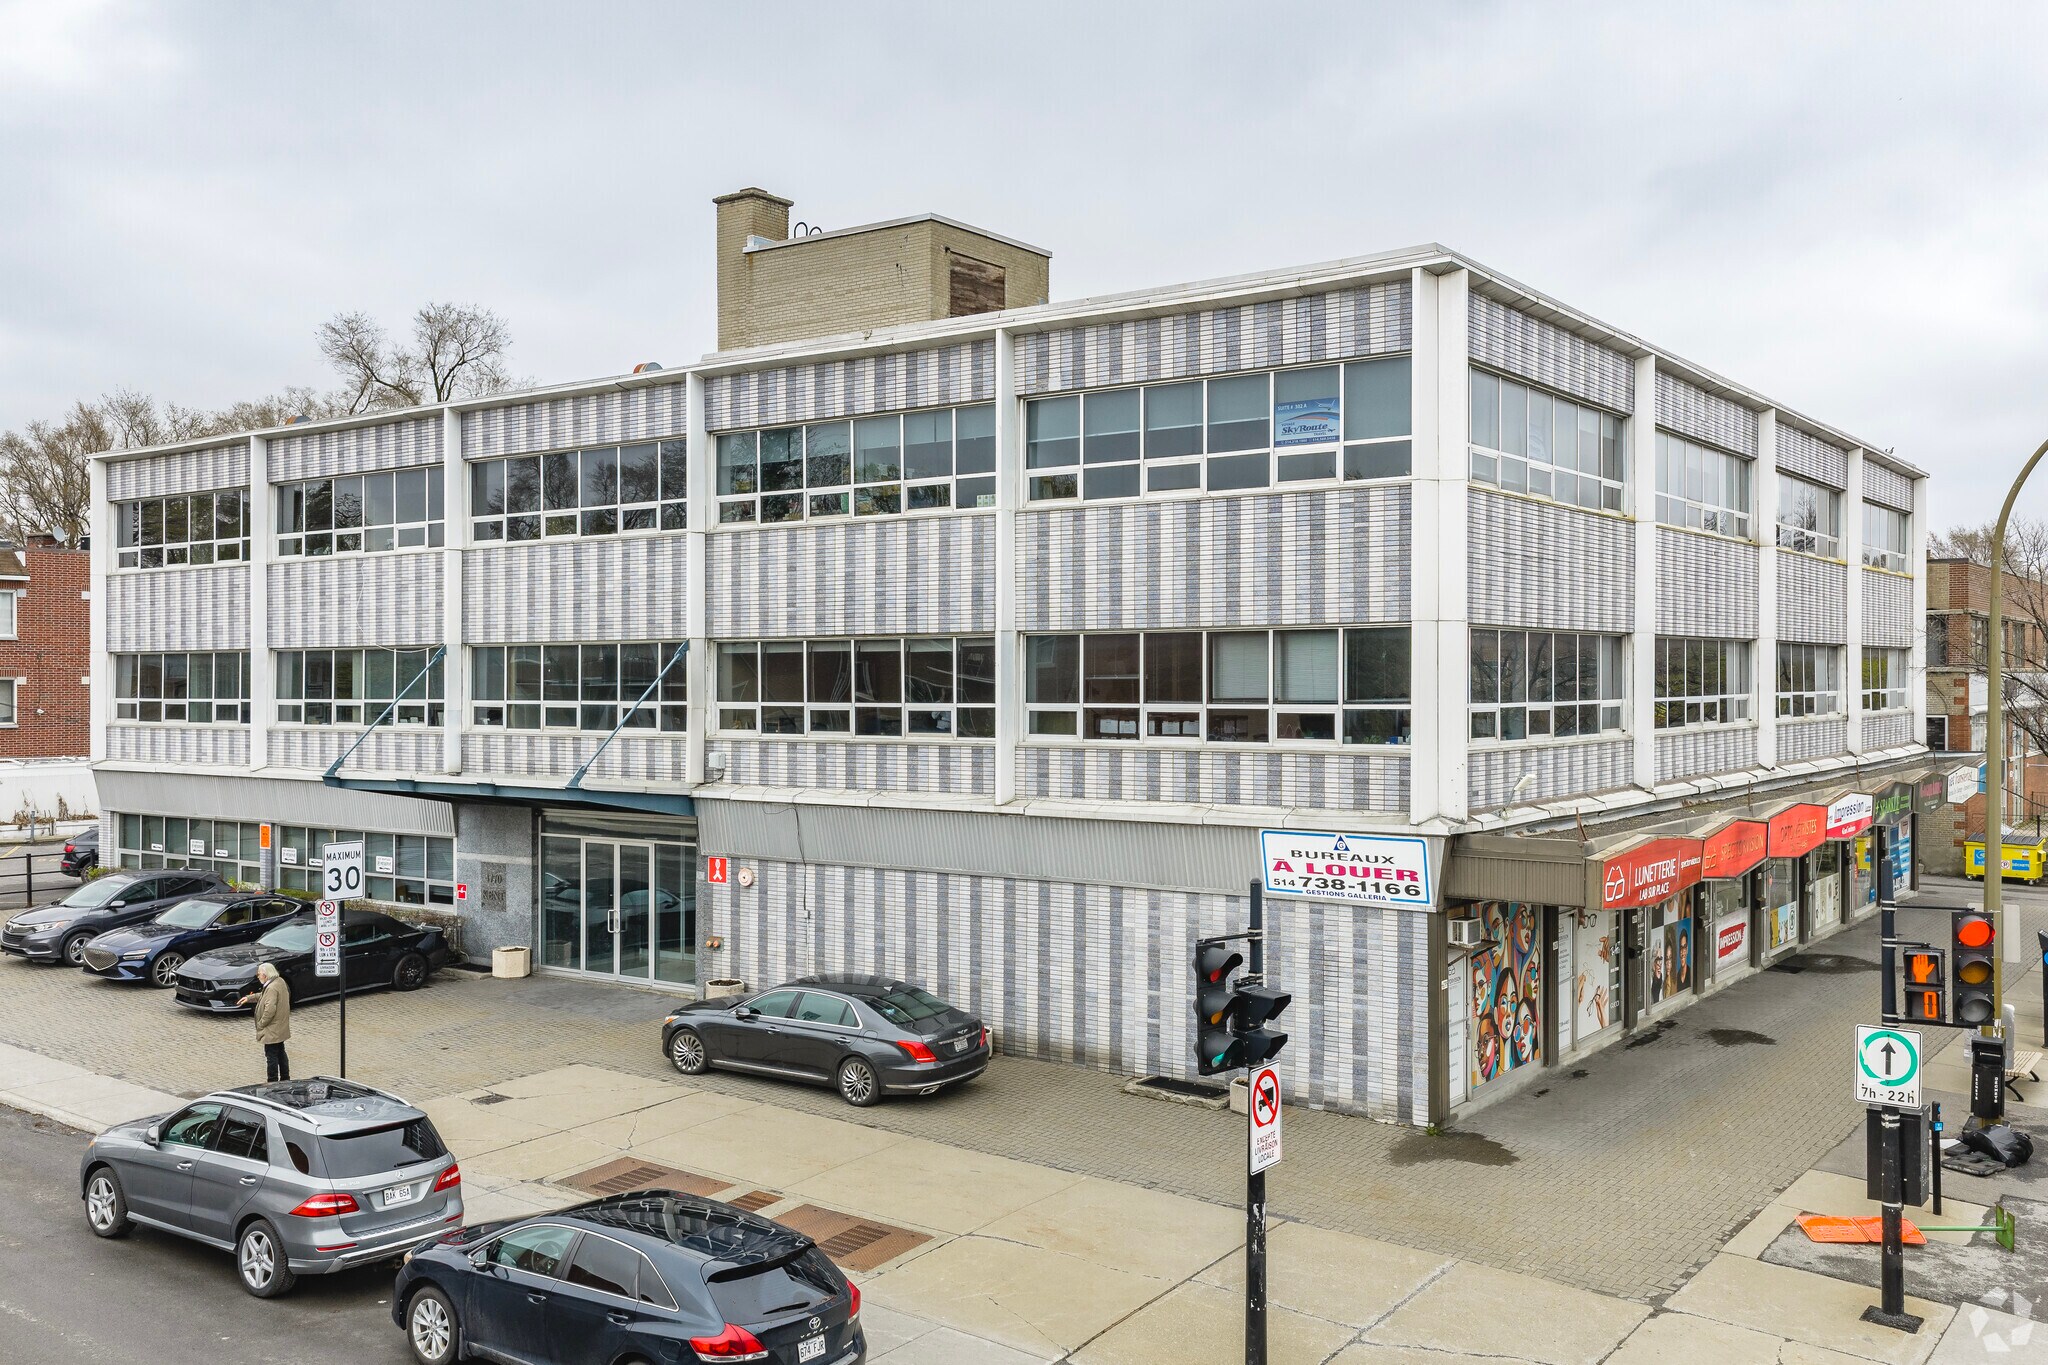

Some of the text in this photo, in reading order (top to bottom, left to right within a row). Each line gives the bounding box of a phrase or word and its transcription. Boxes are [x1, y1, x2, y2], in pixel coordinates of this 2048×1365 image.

[326, 850, 361, 861] MAXIMUM
[1291, 850, 1395, 864] BUREAUX
[327, 866, 361, 892] 30
[1306, 862, 1419, 882] LOUER
[1634, 858, 1676, 887] LUNETTERIE
[1273, 876, 1421, 897] 514 738-1166
[1306, 889, 1387, 901] GESTIONS GALLERIA
[1639, 881, 1670, 901] LAB SUR PLACE
[1861, 1086, 1876, 1099] 7h
[1887, 1090, 1915, 1104] 22h
[1255, 1140, 1277, 1155] LIVRAISON
[1258, 1150, 1274, 1163] LOCALE
